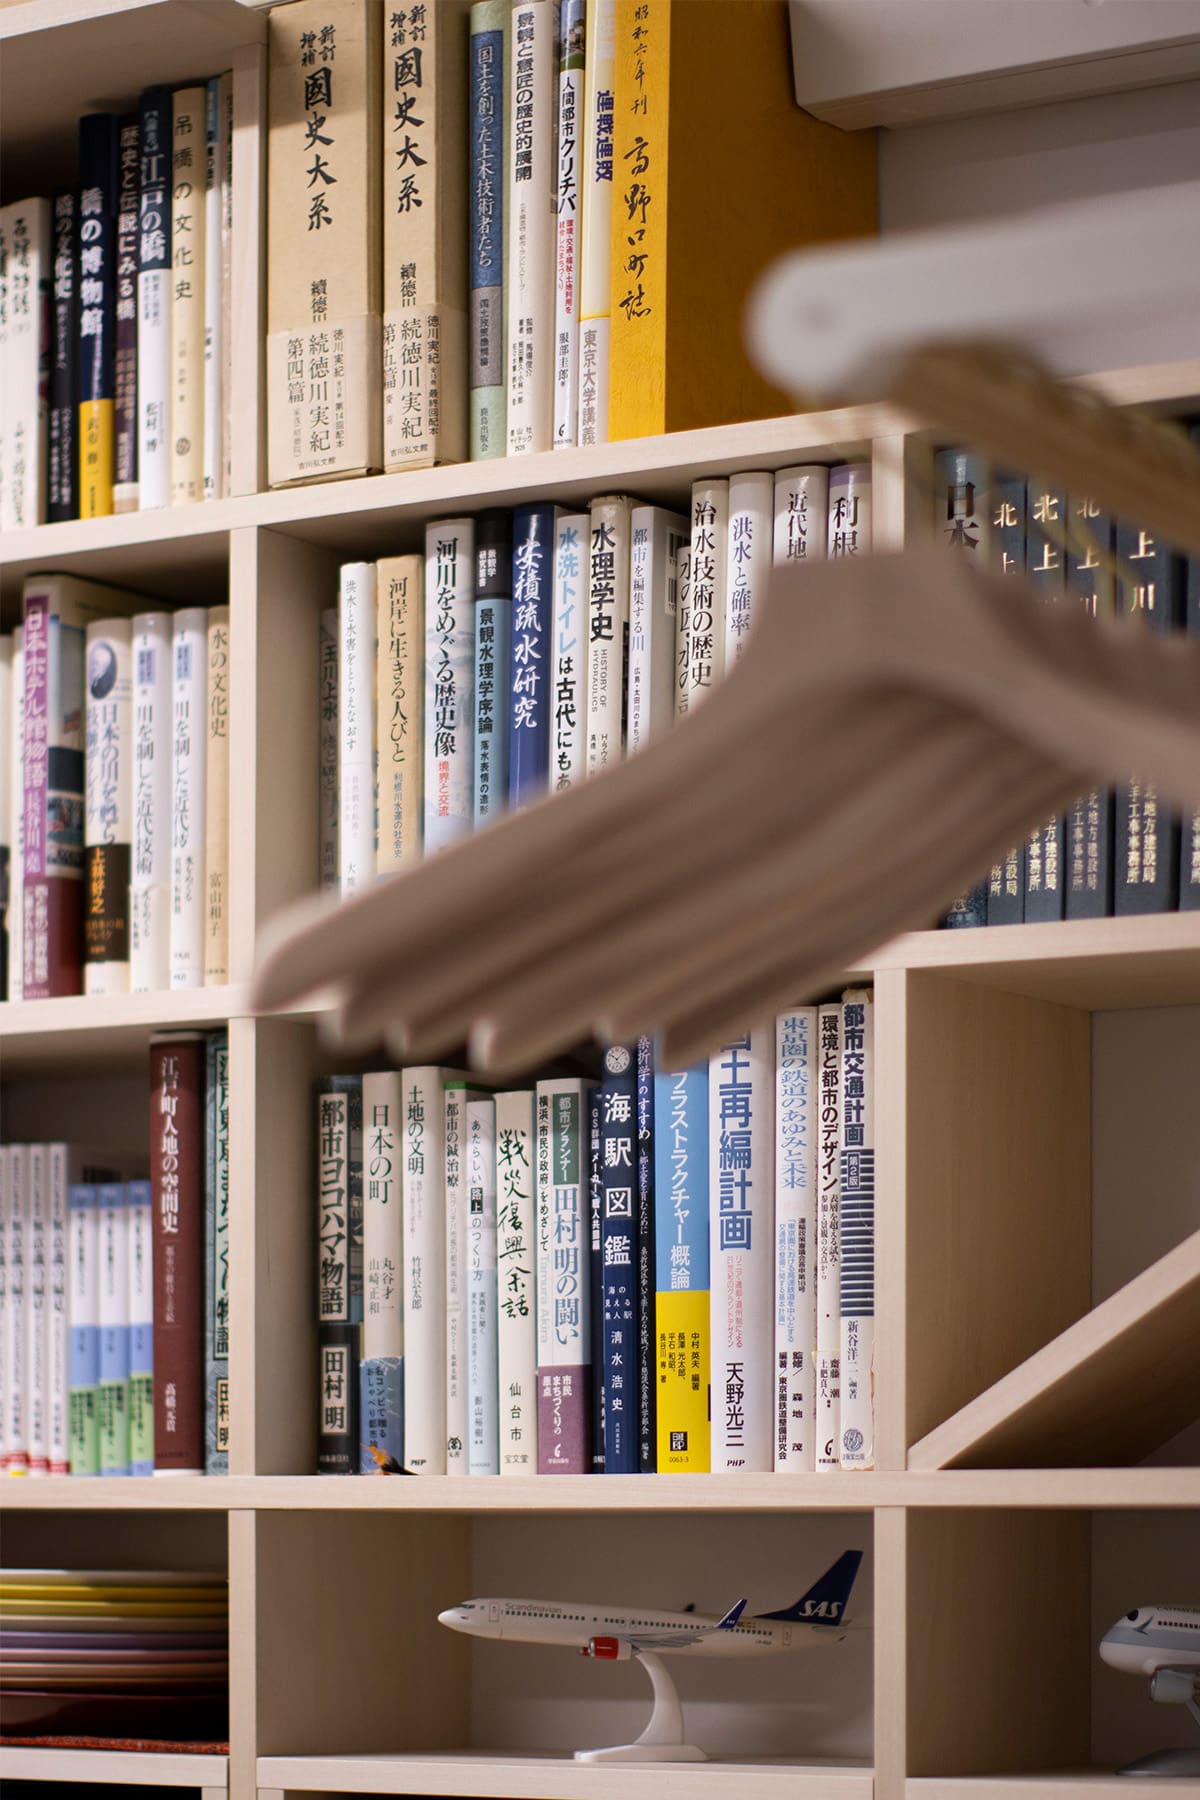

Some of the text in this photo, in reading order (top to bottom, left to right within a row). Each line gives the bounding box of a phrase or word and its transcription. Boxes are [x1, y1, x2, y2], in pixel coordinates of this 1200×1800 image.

[515, 11, 535, 183] 景観と意匠の歴史的展開
[631, 4, 650, 115] 昭和六年刊
[303, 66, 338, 231] 國史大系
[393, 46, 428, 214] 國史大系
[476, 45, 496, 267] 国土を創った土木技術者たち
[558, 76, 577, 215] 人間都市クリチバ
[138, 155, 167, 264] 江戸の橋
[174, 115, 193, 300] 吊橋の文化史
[619, 136, 652, 321] 高野口町誌
[288, 338, 305, 404] 第四篇
[308, 332, 331, 453] 続徳川実紀
[401, 318, 423, 439] 続徳川実紀
[582, 329, 597, 446] 東京大学講義
[590, 522, 616, 644] 水理学史
[731, 516, 753, 637] 洪水と確率
[786, 491, 808, 560] 近代地
[832, 496, 860, 558] 利根
[434, 537, 458, 758] 河川をめぐる歴史像
[632, 528, 647, 651] 都市を編集する川
[692, 500, 717, 690] 治水技術の歴史
[211, 627, 228, 738] 水の文化史
[389, 576, 408, 763] 河岸に生きる人びと
[478, 608, 495, 734] 景観水理学序論
[600, 695, 607, 708] OF
[407, 1085, 424, 1176] 土地の文明
[781, 1016, 808, 1189] 東京圏の鉄道のあゆみと未来
[821, 1015, 839, 1192] 環境と都市のデザイン
[844, 1003, 865, 1148] 都市交通計画
[160, 1056, 179, 1234] 江戸町人地の空間史
[369, 1104, 393, 1205] 日本の町
[559, 1096, 572, 1183] 都市プランナー
[604, 1092, 633, 1266] 海駅図鑑
[670, 1071, 690, 1289] フラストラクチャー概論
[848, 1155, 859, 1187] 第2版
[320, 1100, 345, 1315] 都市ヨコハマ物語
[471, 1120, 484, 1282] あたらしい路上のつくり方
[553, 1187, 580, 1345] 田村明の闘い
[325, 1351, 344, 1429] 田村 明
[562, 1375, 572, 1397] 市民
[611, 1330, 624, 1411] 清水浩史
[691, 1332, 700, 1349] 中村
[509, 1382, 523, 1442] 仙台市
[552, 1375, 562, 1435] まちづくりの
[726, 1362, 745, 1447] 天野光三
[727, 1459, 745, 1467] PHP
[505, 1602, 562, 1614] Scandinavian
[798, 1600, 842, 1618] SAS
